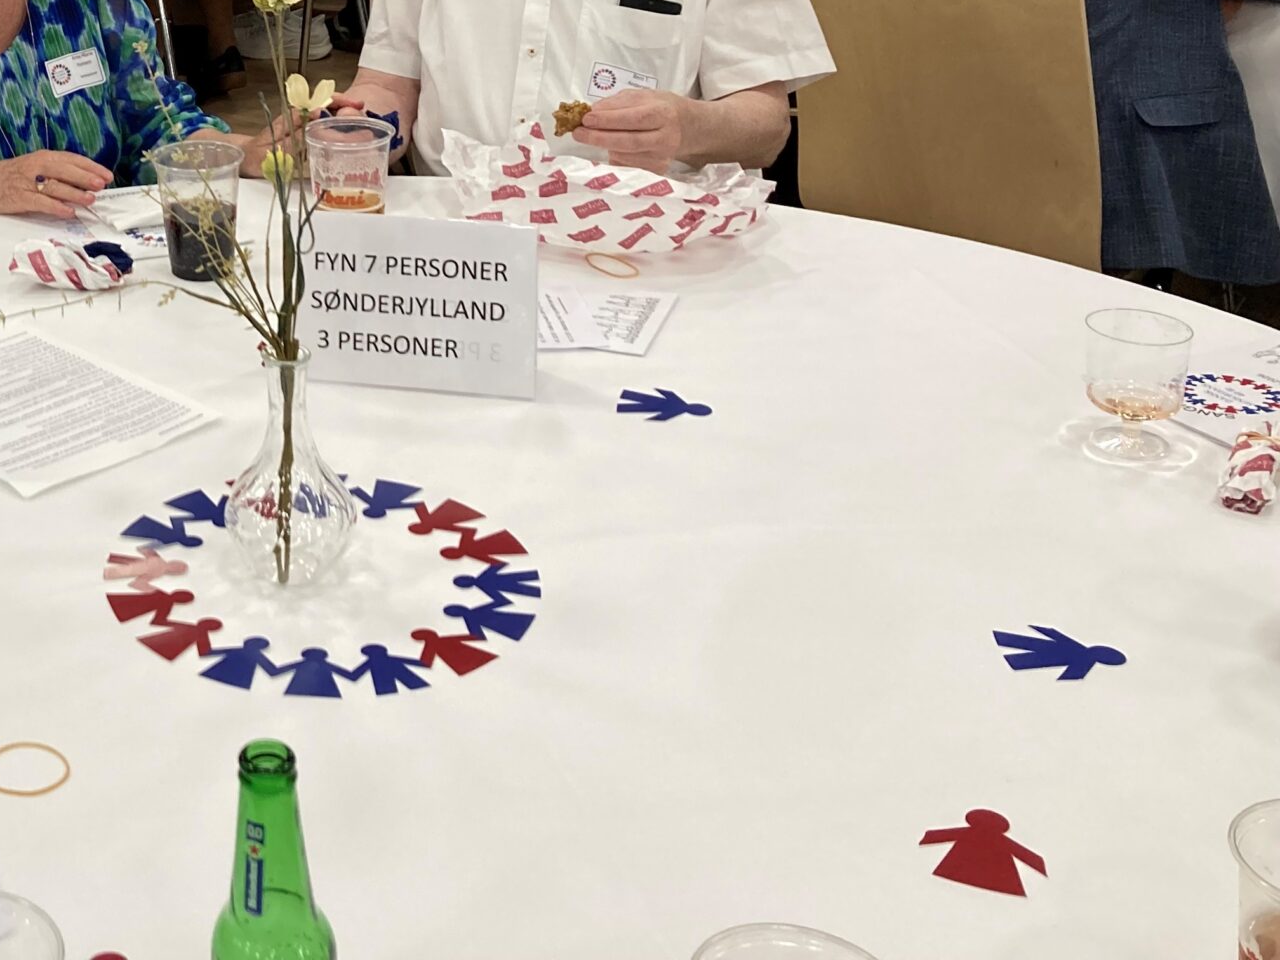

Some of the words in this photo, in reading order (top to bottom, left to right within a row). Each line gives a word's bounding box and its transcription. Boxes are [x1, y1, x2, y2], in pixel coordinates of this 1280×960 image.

[314, 251, 357, 273] FYN
[364, 254, 377, 274] 7
[385, 255, 509, 282] PERSONER
[310, 289, 506, 322] SØNDERJYLLAND
[317, 329, 329, 349] 3
[338, 330, 459, 359] PERSONER
